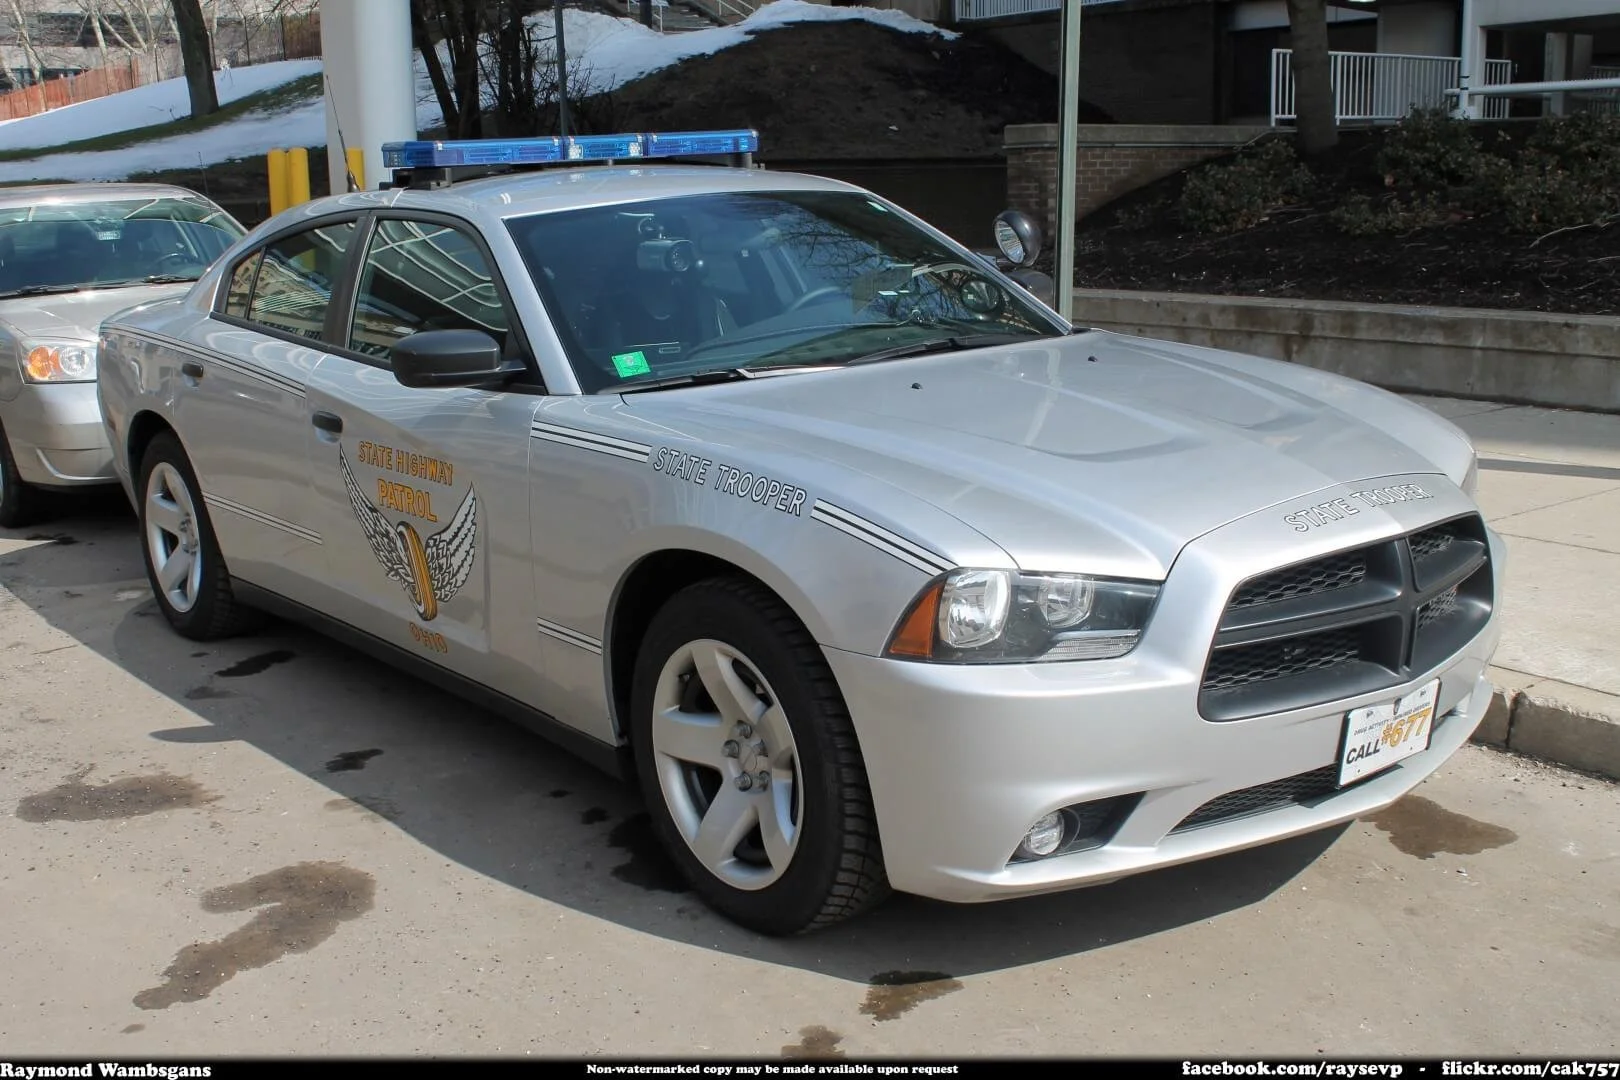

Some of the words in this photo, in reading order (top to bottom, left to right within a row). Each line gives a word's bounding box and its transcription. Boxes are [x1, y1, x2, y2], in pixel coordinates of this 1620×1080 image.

[359, 441, 393, 470] STATE
[396, 449, 454, 486] HIGHWAY
[653, 446, 712, 485] STATE
[714, 463, 807, 517] TROOPER
[377, 478, 438, 523] PATROL
[1283, 497, 1360, 533] STATE
[1350, 483, 1434, 508] TROOPER
[409, 621, 448, 654] OHIO
[1346, 739, 1381, 765] CALL
[1381, 706, 1432, 748] #677
